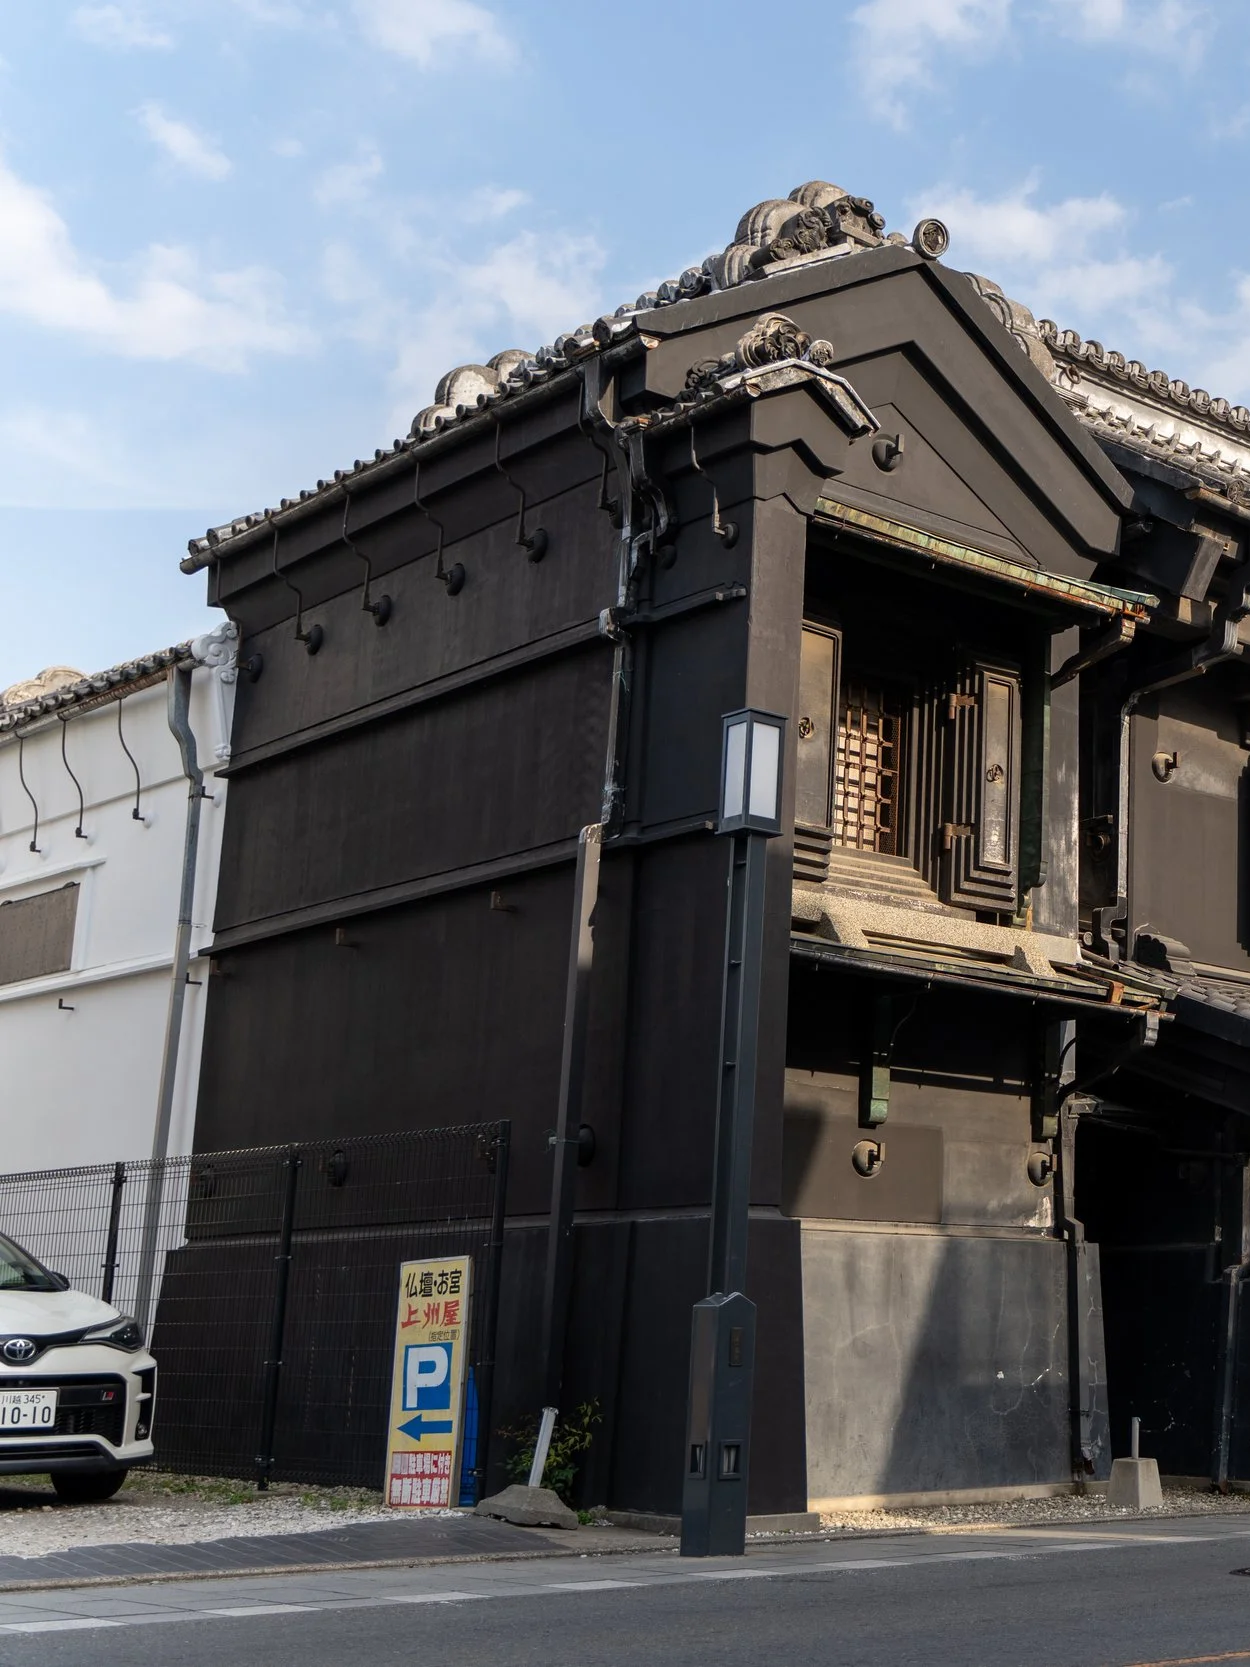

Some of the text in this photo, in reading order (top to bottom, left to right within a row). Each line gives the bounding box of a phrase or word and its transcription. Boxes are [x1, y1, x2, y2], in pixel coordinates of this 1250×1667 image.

[405, 1269, 462, 1298] 仏壇・お宮
[401, 1300, 461, 1329] 上州屋
[406, 1346, 448, 1408] P
[23, 1394, 42, 1405] 345
[2, 1406, 51, 1425] 10-10
[392, 1452, 451, 1474] 駐車場に付き
